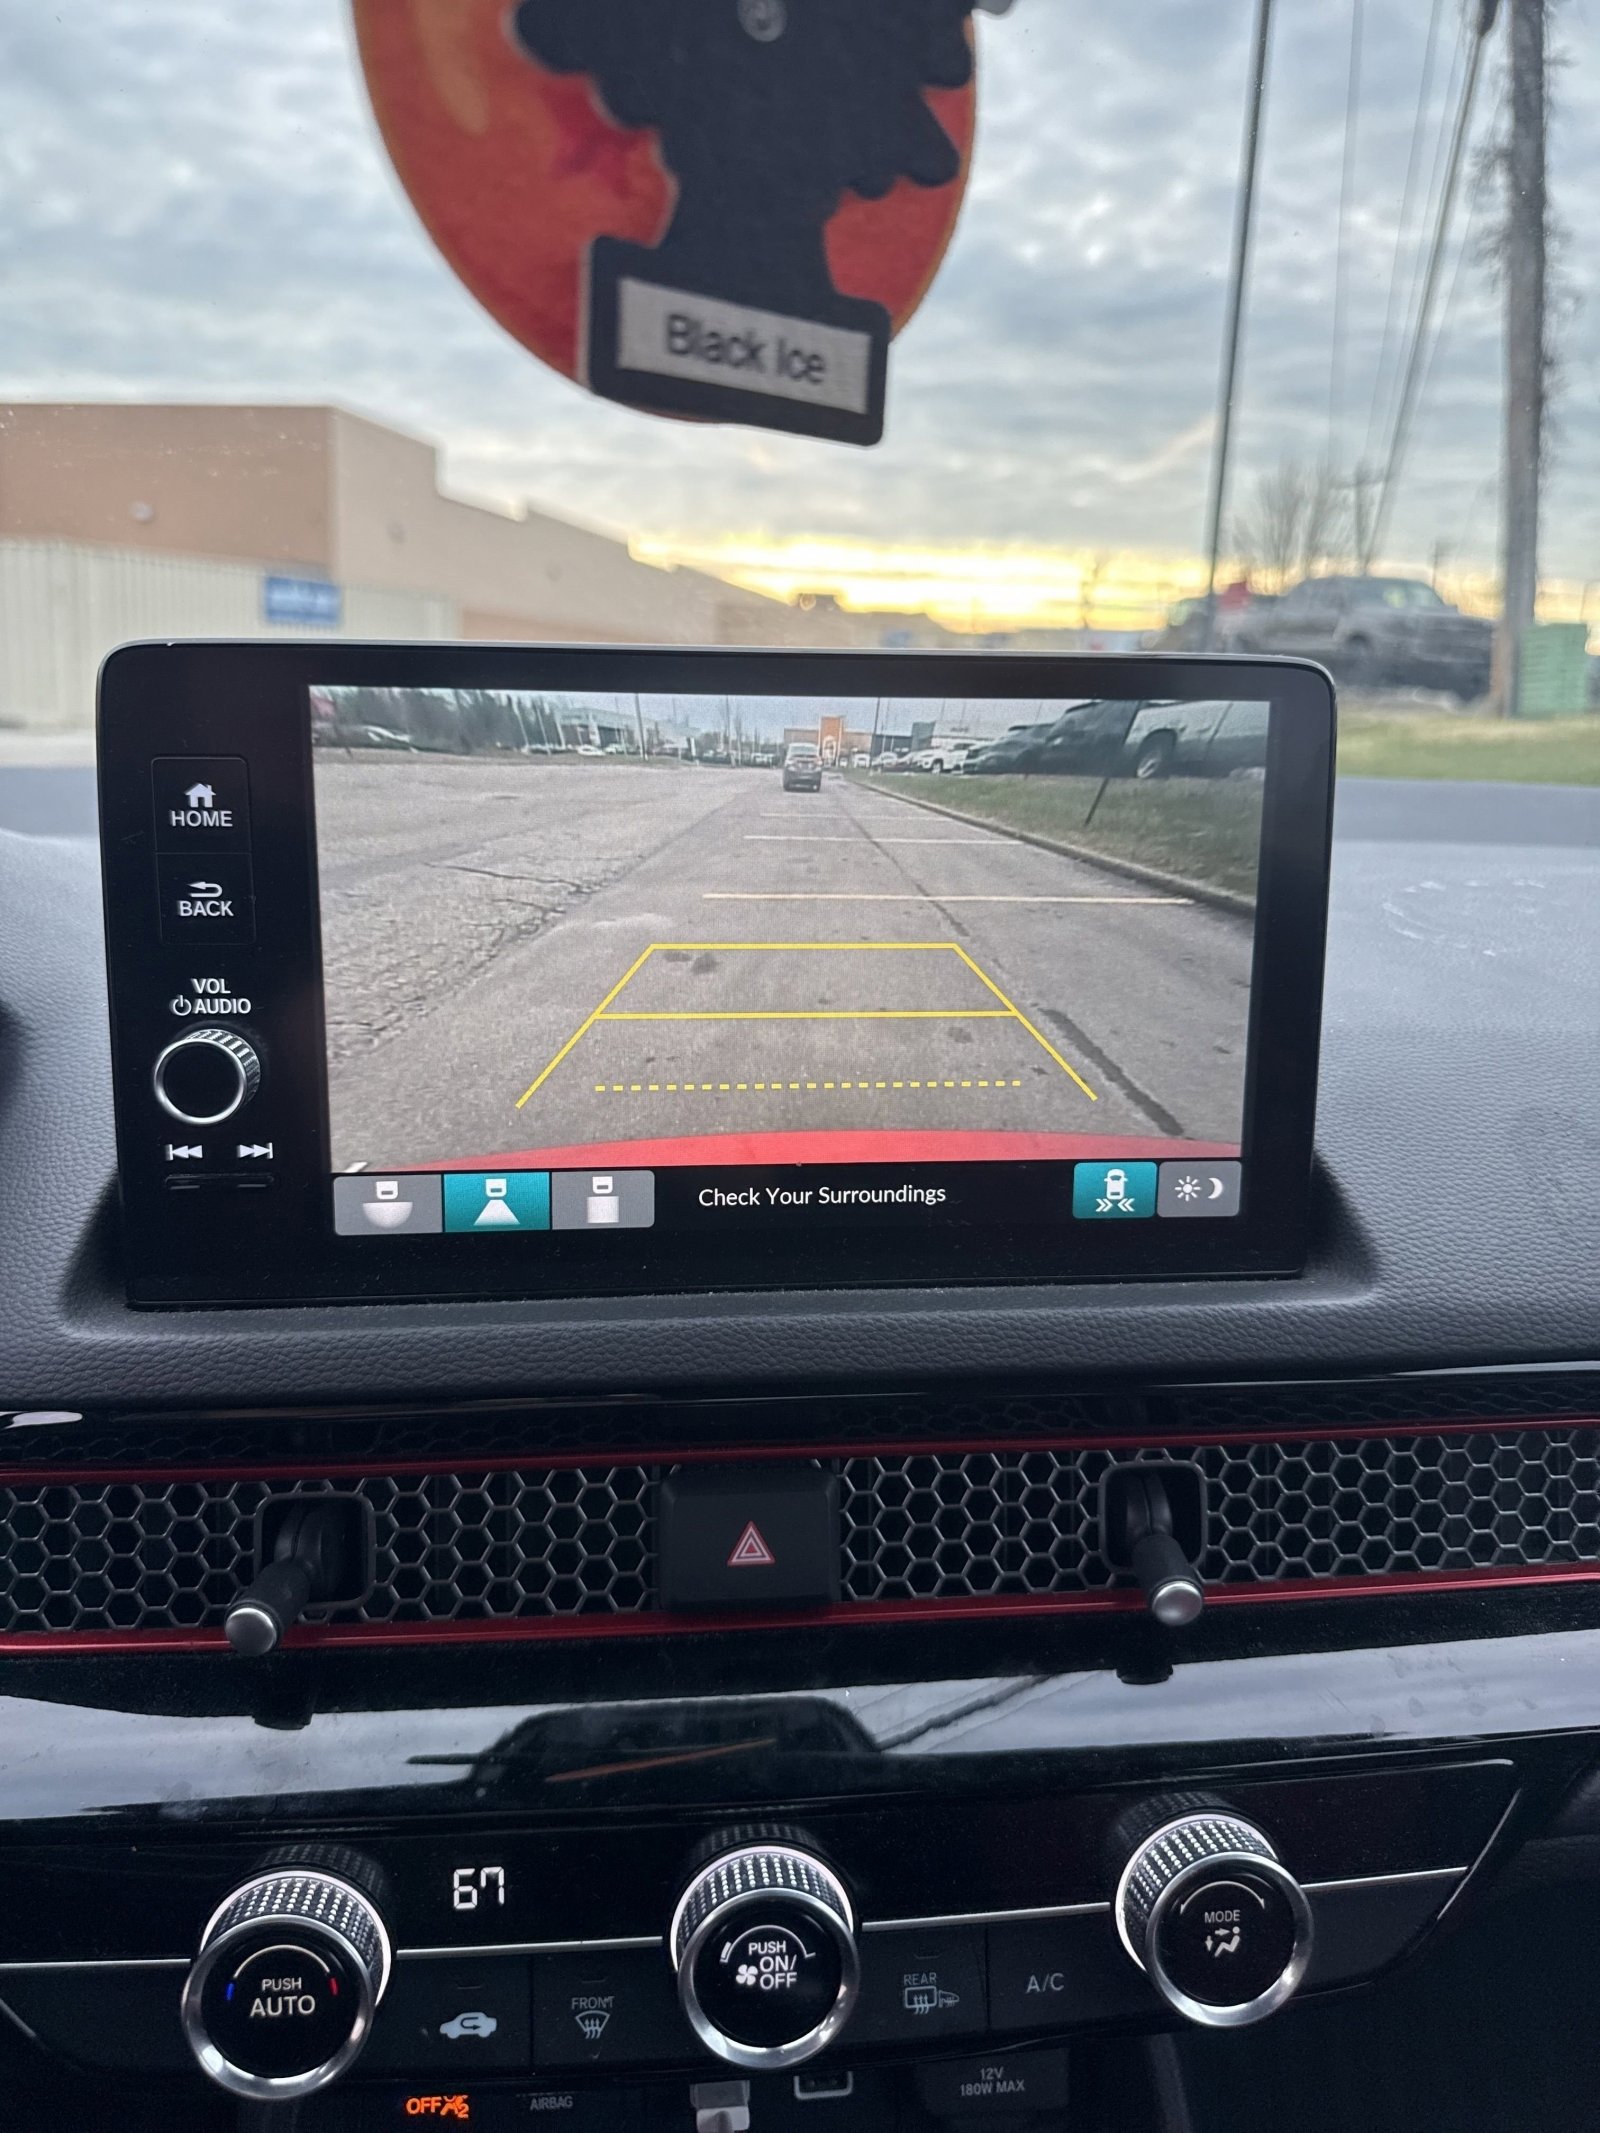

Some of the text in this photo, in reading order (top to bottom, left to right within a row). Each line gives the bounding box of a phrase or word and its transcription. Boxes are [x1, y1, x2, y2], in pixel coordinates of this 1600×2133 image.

[665, 312, 826, 384] Black Ice
[170, 810, 233, 827] HOME
[178, 900, 234, 917] BACK
[191, 978, 231, 994] VOL
[193, 998, 251, 1014] AUDIO
[698, 1184, 947, 1206] Check Your Surroundings
[452, 1866, 505, 1911] 67
[1204, 1909, 1241, 1923] MODE
[748, 1940, 787, 1956] PUSH
[760, 1954, 798, 1973] ON/
[261, 1976, 302, 1993] PUSH
[760, 1971, 798, 1990] OFF
[903, 1972, 937, 1986] REAR
[1026, 1972, 1065, 1994] A/C
[249, 1995, 316, 2018] AUTO
[571, 1996, 615, 2010] FRONT
[980, 2067, 1005, 2081] 12V
[960, 2079, 1026, 2096] 180W MAX
[405, 2096, 442, 2115] OFF
[530, 2095, 574, 2111] AIRBAG
